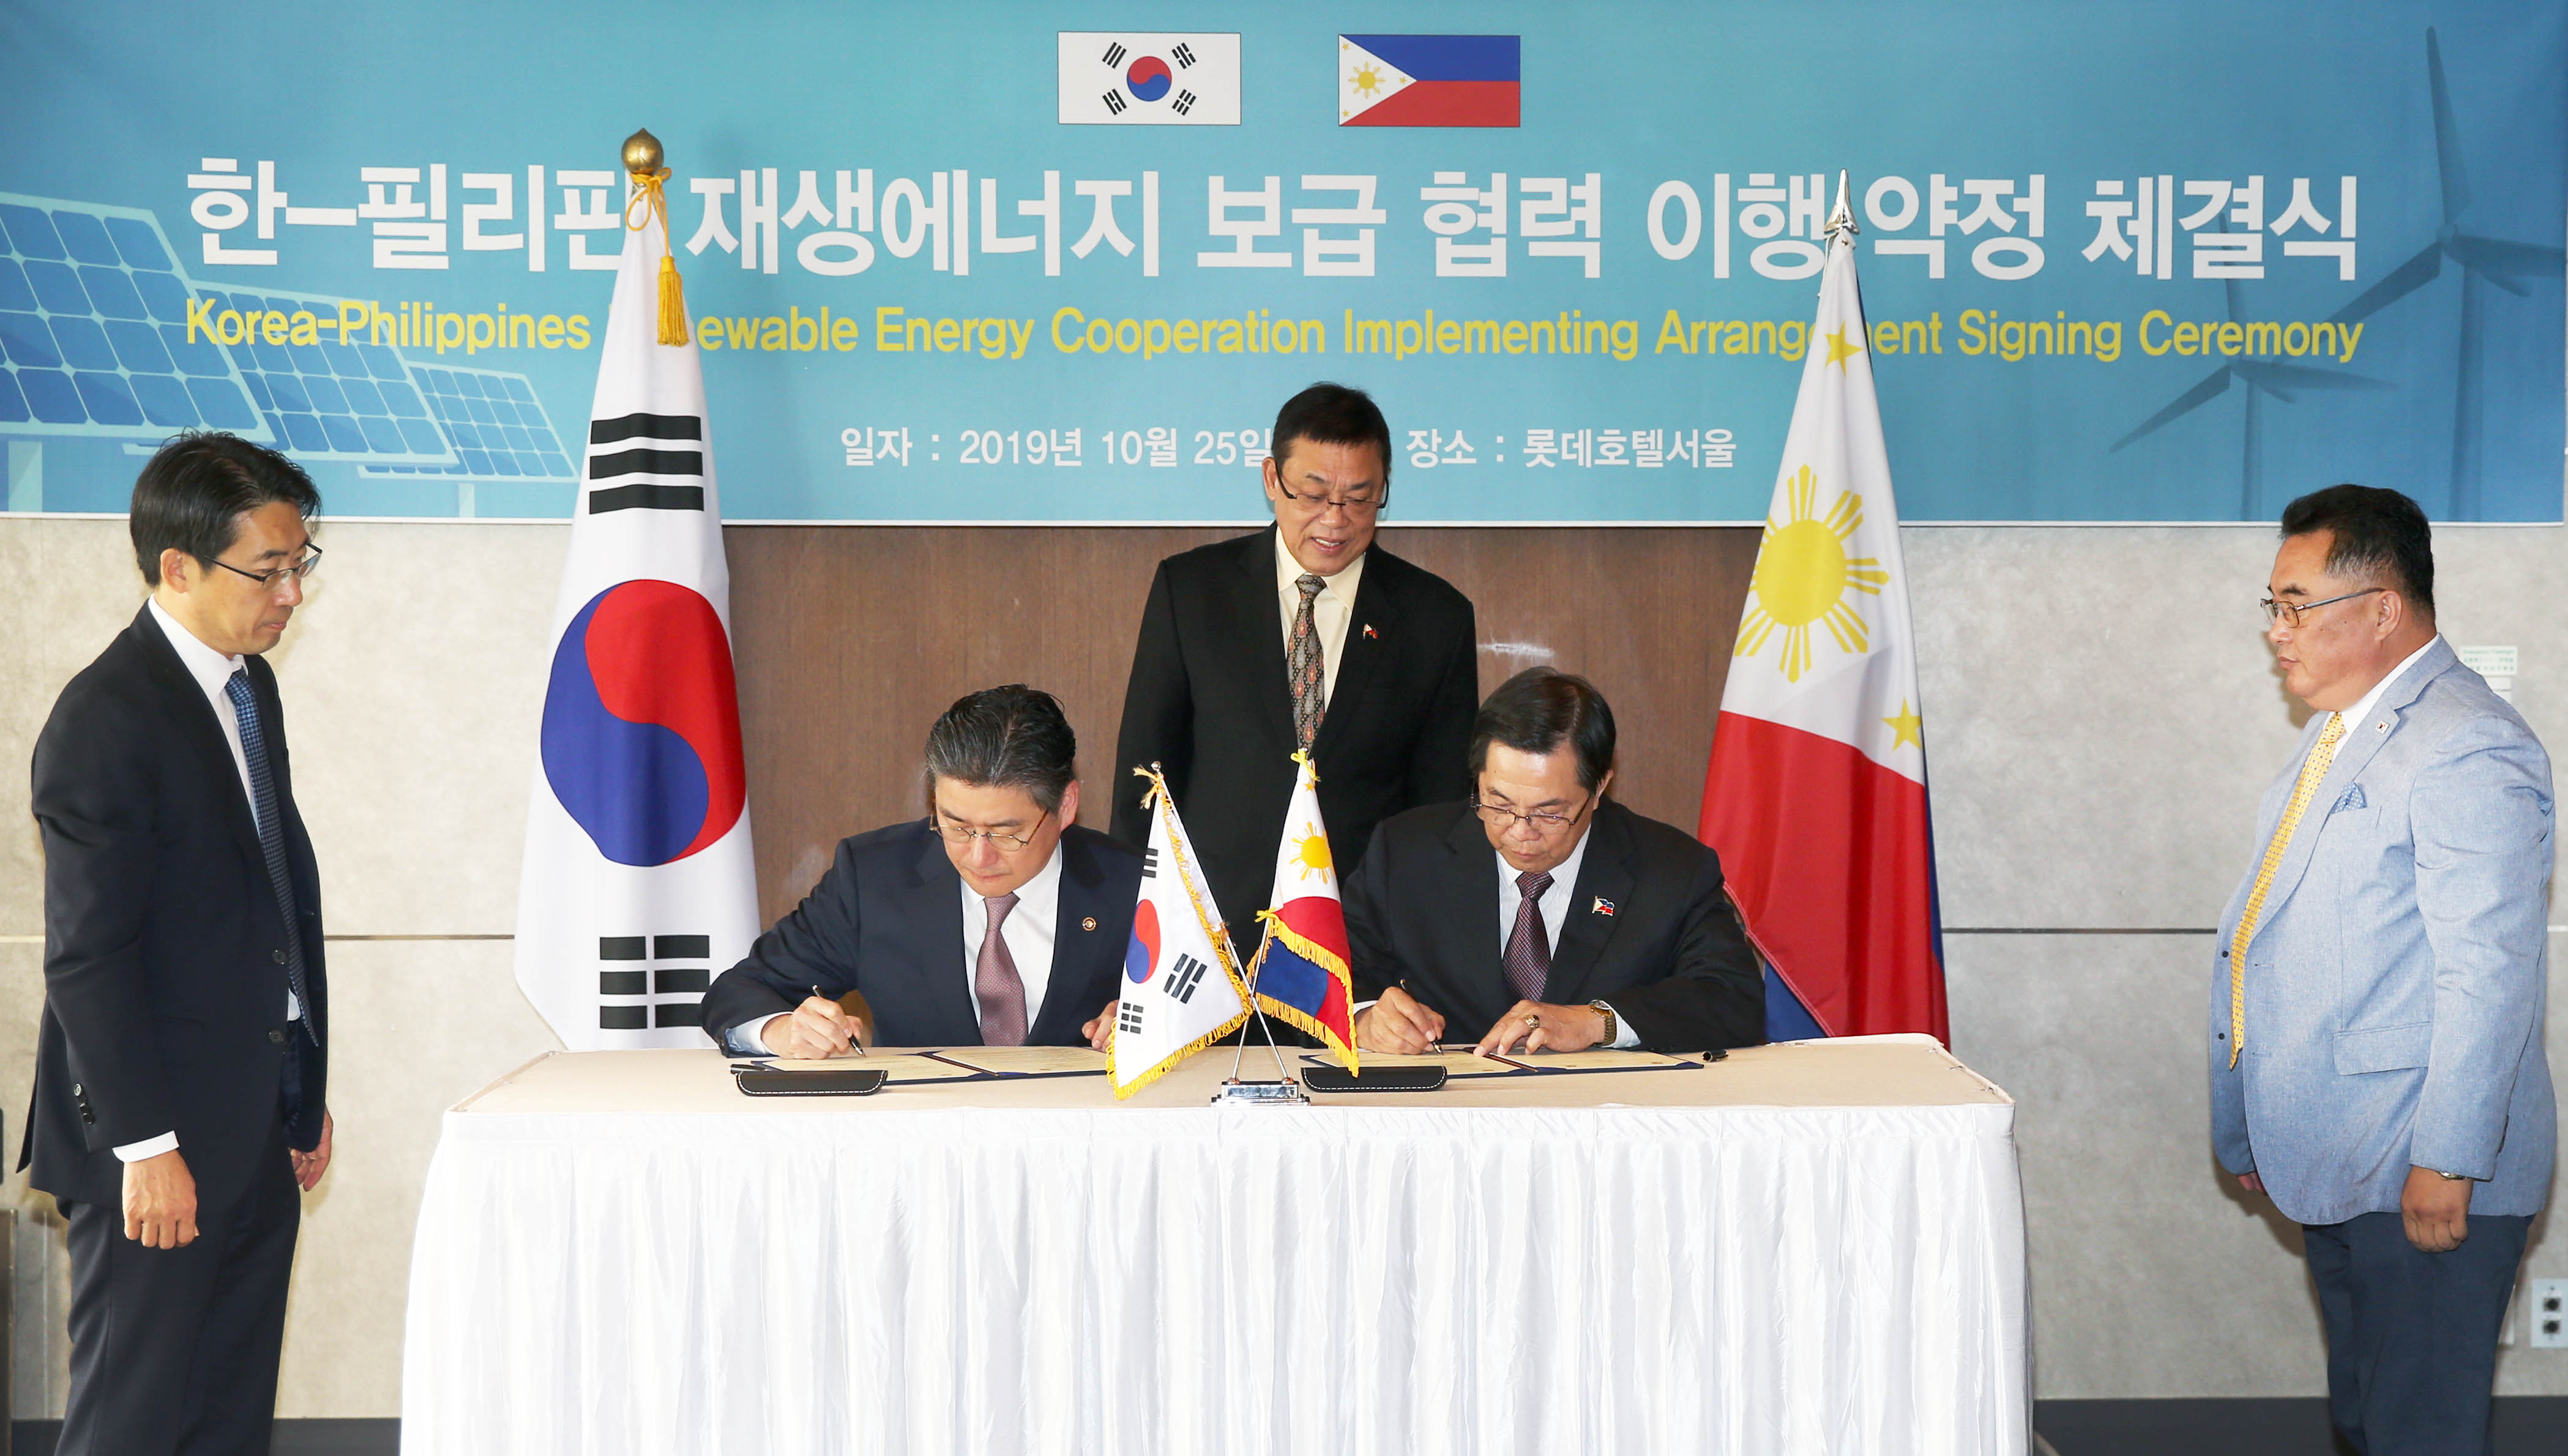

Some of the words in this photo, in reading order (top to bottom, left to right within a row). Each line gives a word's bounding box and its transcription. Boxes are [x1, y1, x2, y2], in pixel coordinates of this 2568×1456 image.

[685, 168, 1160, 277] 재생에너지
[1197, 174, 1387, 277] 보급
[1420, 171, 1602, 278] 협력
[1647, 173, 1826, 280] 이행
[1864, 174, 2045, 280] 약정
[2081, 174, 2357, 281] 체결식
[187, 298, 591, 355] Korea-Philippines
[608, 304, 859, 352] ewable
[876, 306, 1035, 360] Energy
[1051, 306, 1326, 360] Cooperation
[1345, 308, 1639, 361] Implementing
[1654, 309, 1943, 362] Arrangent
[1958, 309, 2122, 362] Signing
[2139, 310, 2364, 363] Ceremony
[841, 427, 914, 467] 일자
[931, 434, 941, 461] :
[959, 427, 1083, 468] 2019년
[1102, 427, 1179, 468] 10월
[1194, 428, 1271, 467] 25일
[1406, 428, 1477, 468] 장소
[1496, 435, 1504, 462] :
[1522, 428, 1737, 468] 롯데호텔서울
